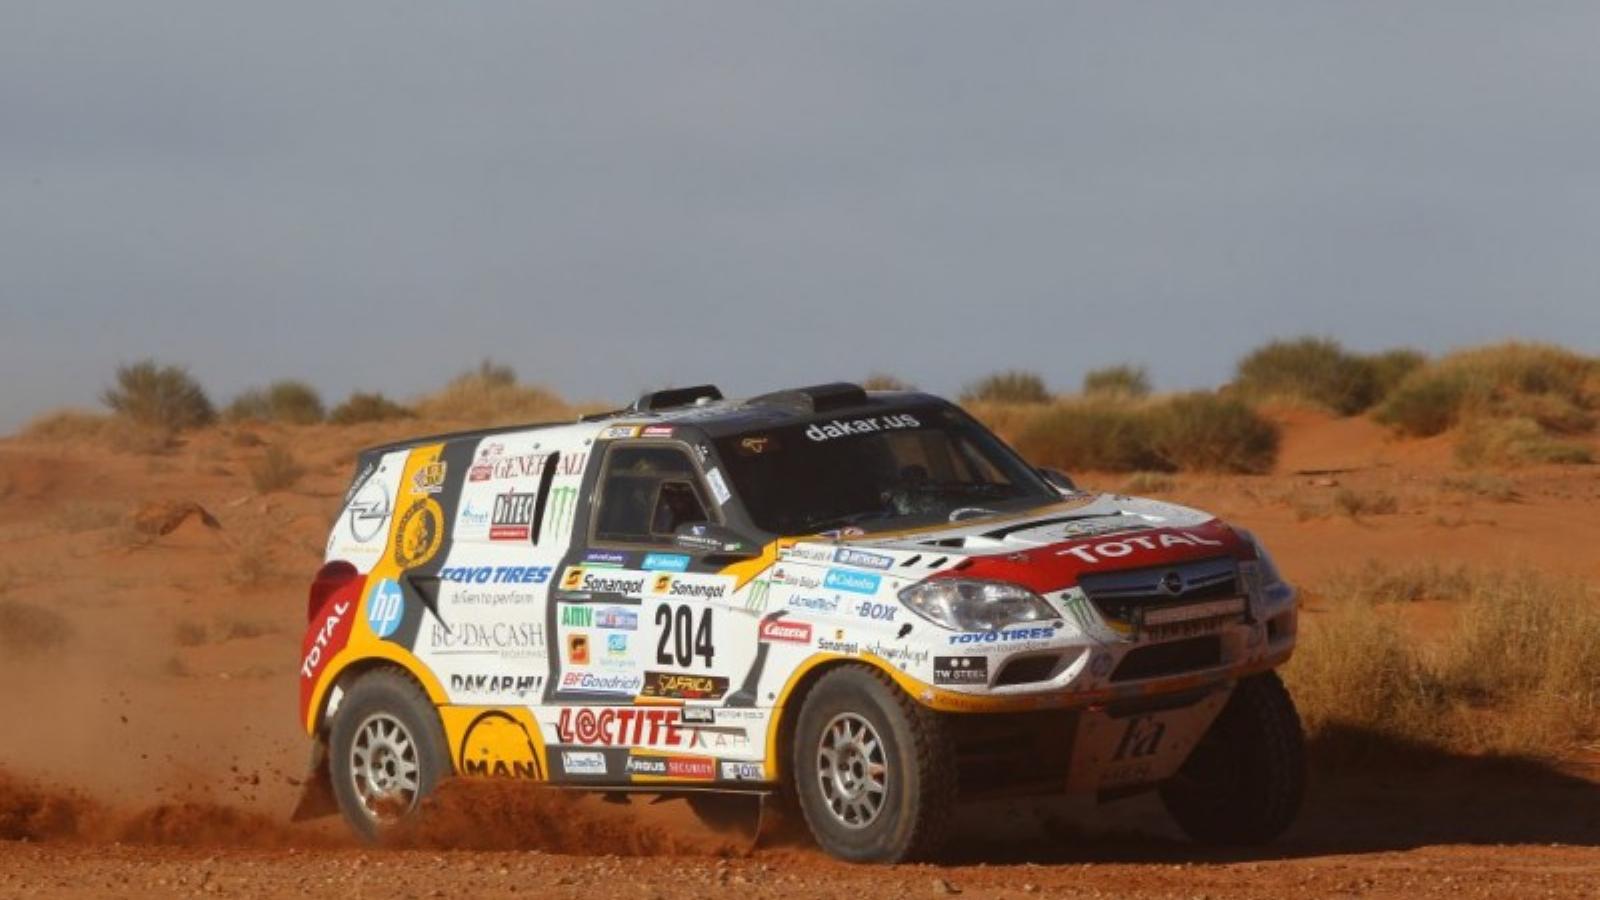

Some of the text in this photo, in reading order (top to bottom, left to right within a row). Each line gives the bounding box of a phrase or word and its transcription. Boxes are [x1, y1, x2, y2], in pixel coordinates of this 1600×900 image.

[804, 413, 921, 442] dakar.us
[1055, 531, 1222, 564] TOTAL
[493, 565, 552, 583] TIRES
[582, 573, 645, 594] Sonangol
[669, 579, 727, 599] Sonangol
[368, 578, 402, 638] hp
[301, 602, 350, 677] TOTAL
[654, 602, 715, 668] 204
[1001, 628, 1055, 642] TIRES
[562, 671, 641, 690] BFGoodrich
[935, 669, 952, 678] TW
[558, 707, 682, 746] LOCTITE
[465, 758, 535, 779] MAN
